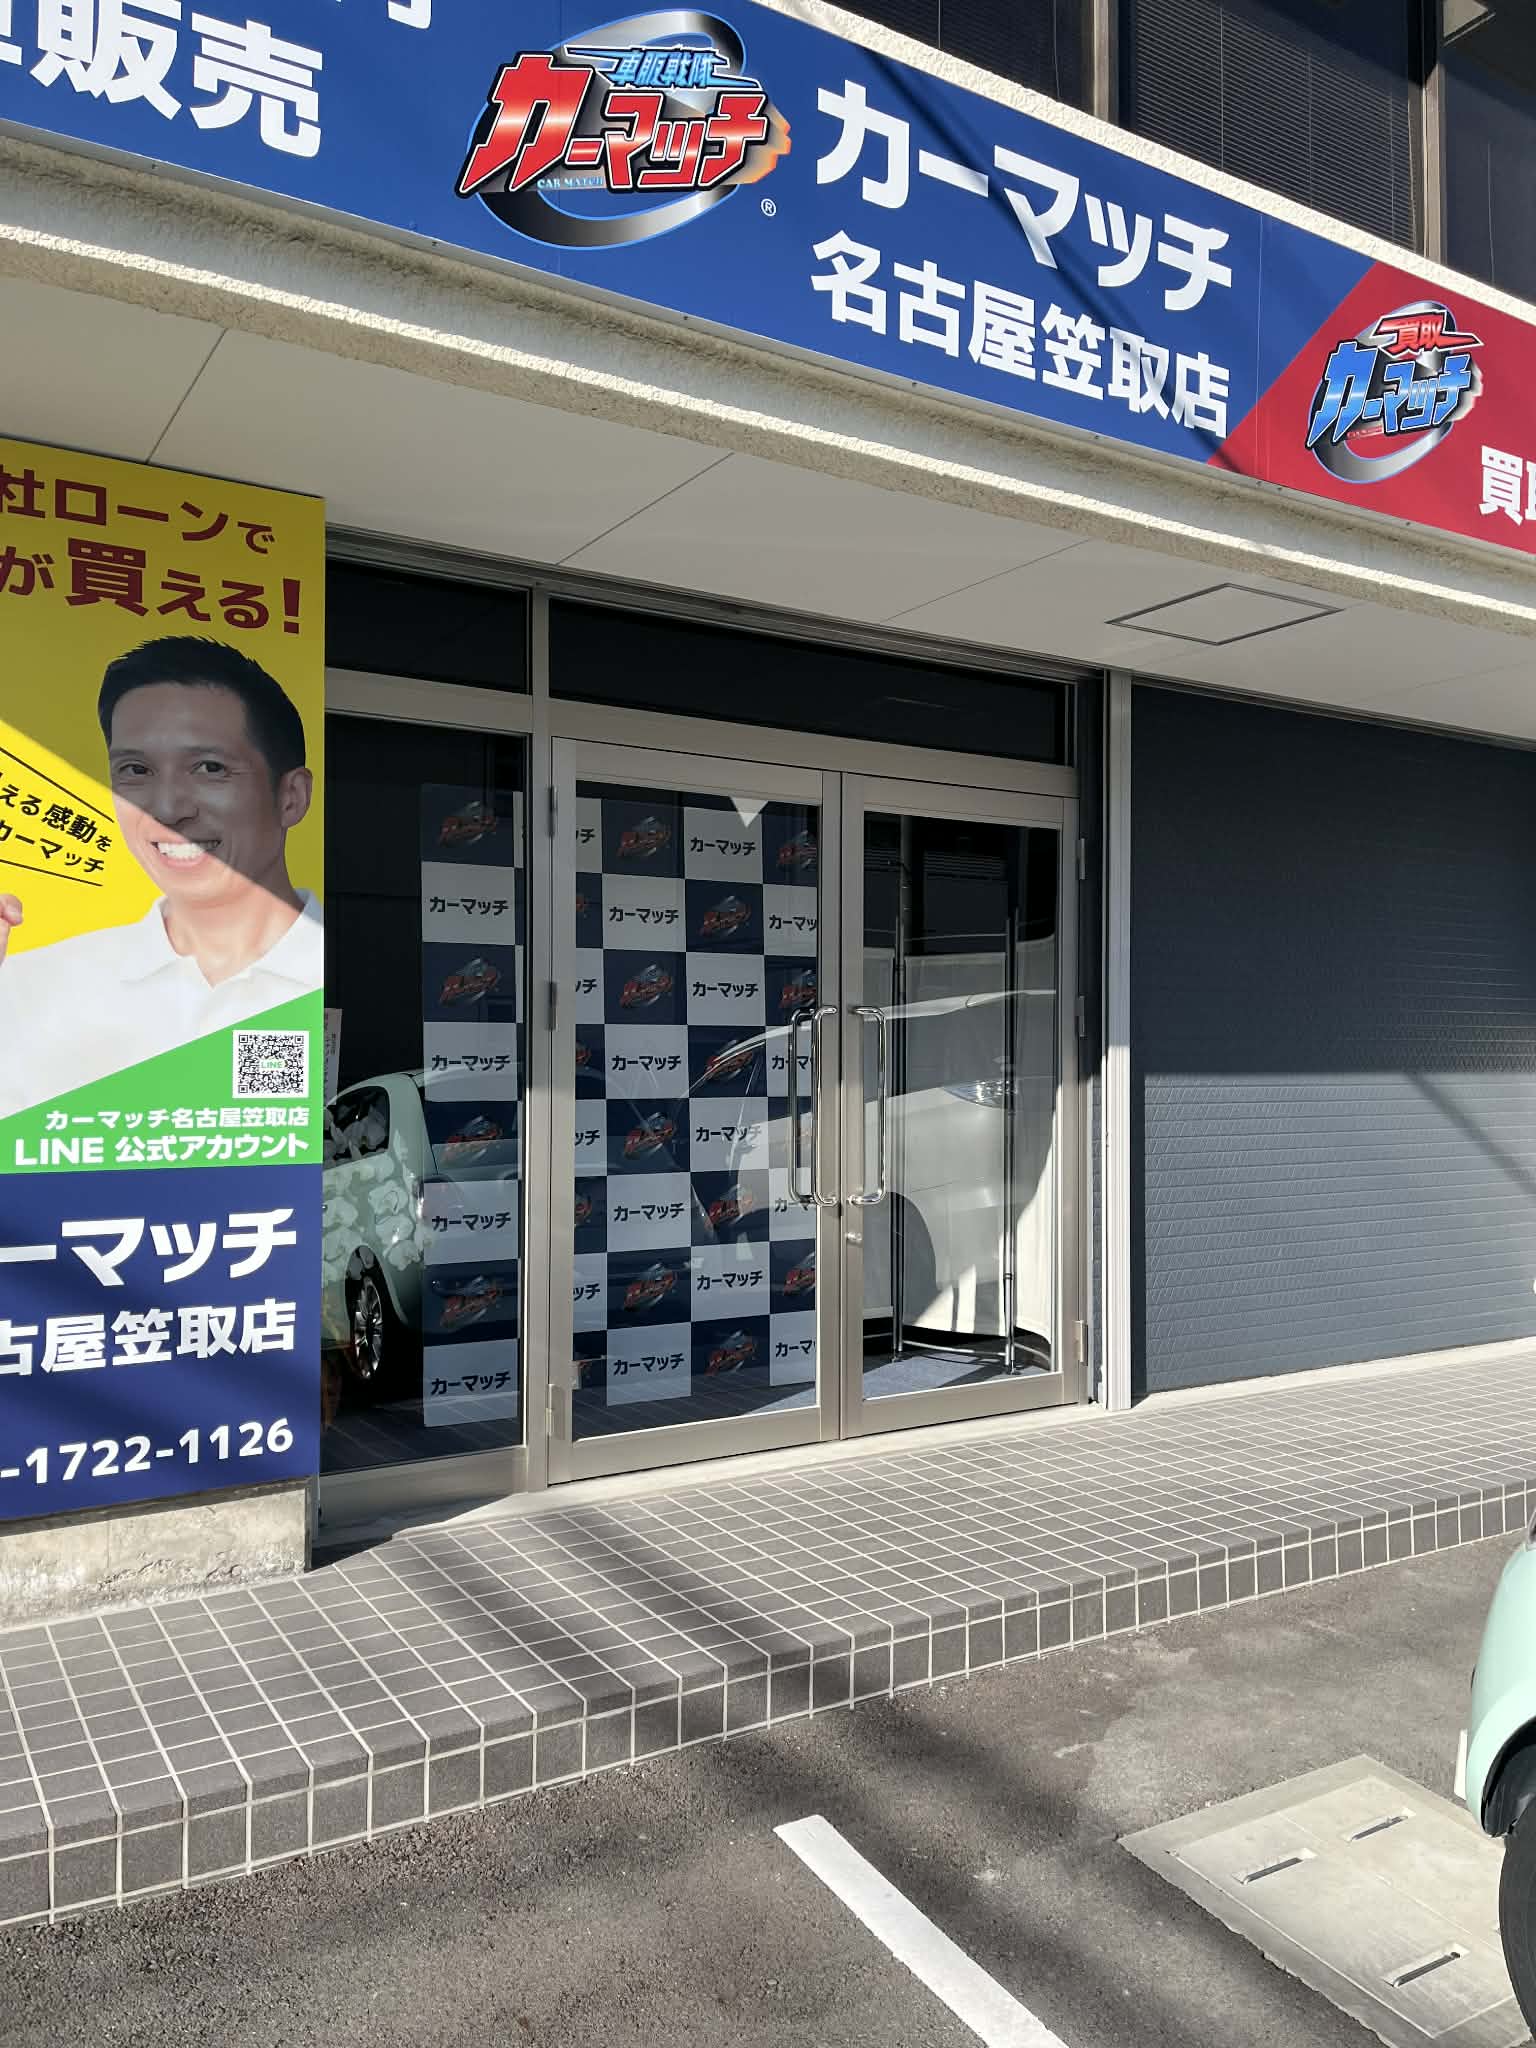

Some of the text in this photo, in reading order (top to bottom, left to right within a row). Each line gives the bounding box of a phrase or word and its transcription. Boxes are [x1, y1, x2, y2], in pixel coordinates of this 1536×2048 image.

[0, 0, 323, 158] 販売
[460, 54, 768, 193] カーマッチ
[816, 79, 1233, 311] カーマッチ
[811, 230, 1230, 440] 名古屋笠取店
[1307, 341, 1472, 447] カーマッチ
[1478, 445, 1536, 526] 買
[690, 836, 756, 856] カーマッチ
[428, 896, 509, 918] カーマッチ
[608, 906, 680, 924] カーマッチ
[692, 981, 759, 998] カーマッチ
[431, 1055, 511, 1072] カーマッチ
[611, 1055, 682, 1071] カーマッチ
[45, 1107, 310, 1131] カーマッチ名古屋笠取店
[15, 1133, 309, 1166] LINE 公式アカウント
[431, 1211, 512, 1232] カーマッチ
[613, 1202, 685, 1222] カーマッチ
[696, 1270, 763, 1291] カーマッチ
[613, 1353, 685, 1376] カーマッチ
[430, 1371, 512, 1396] カーマッチ
